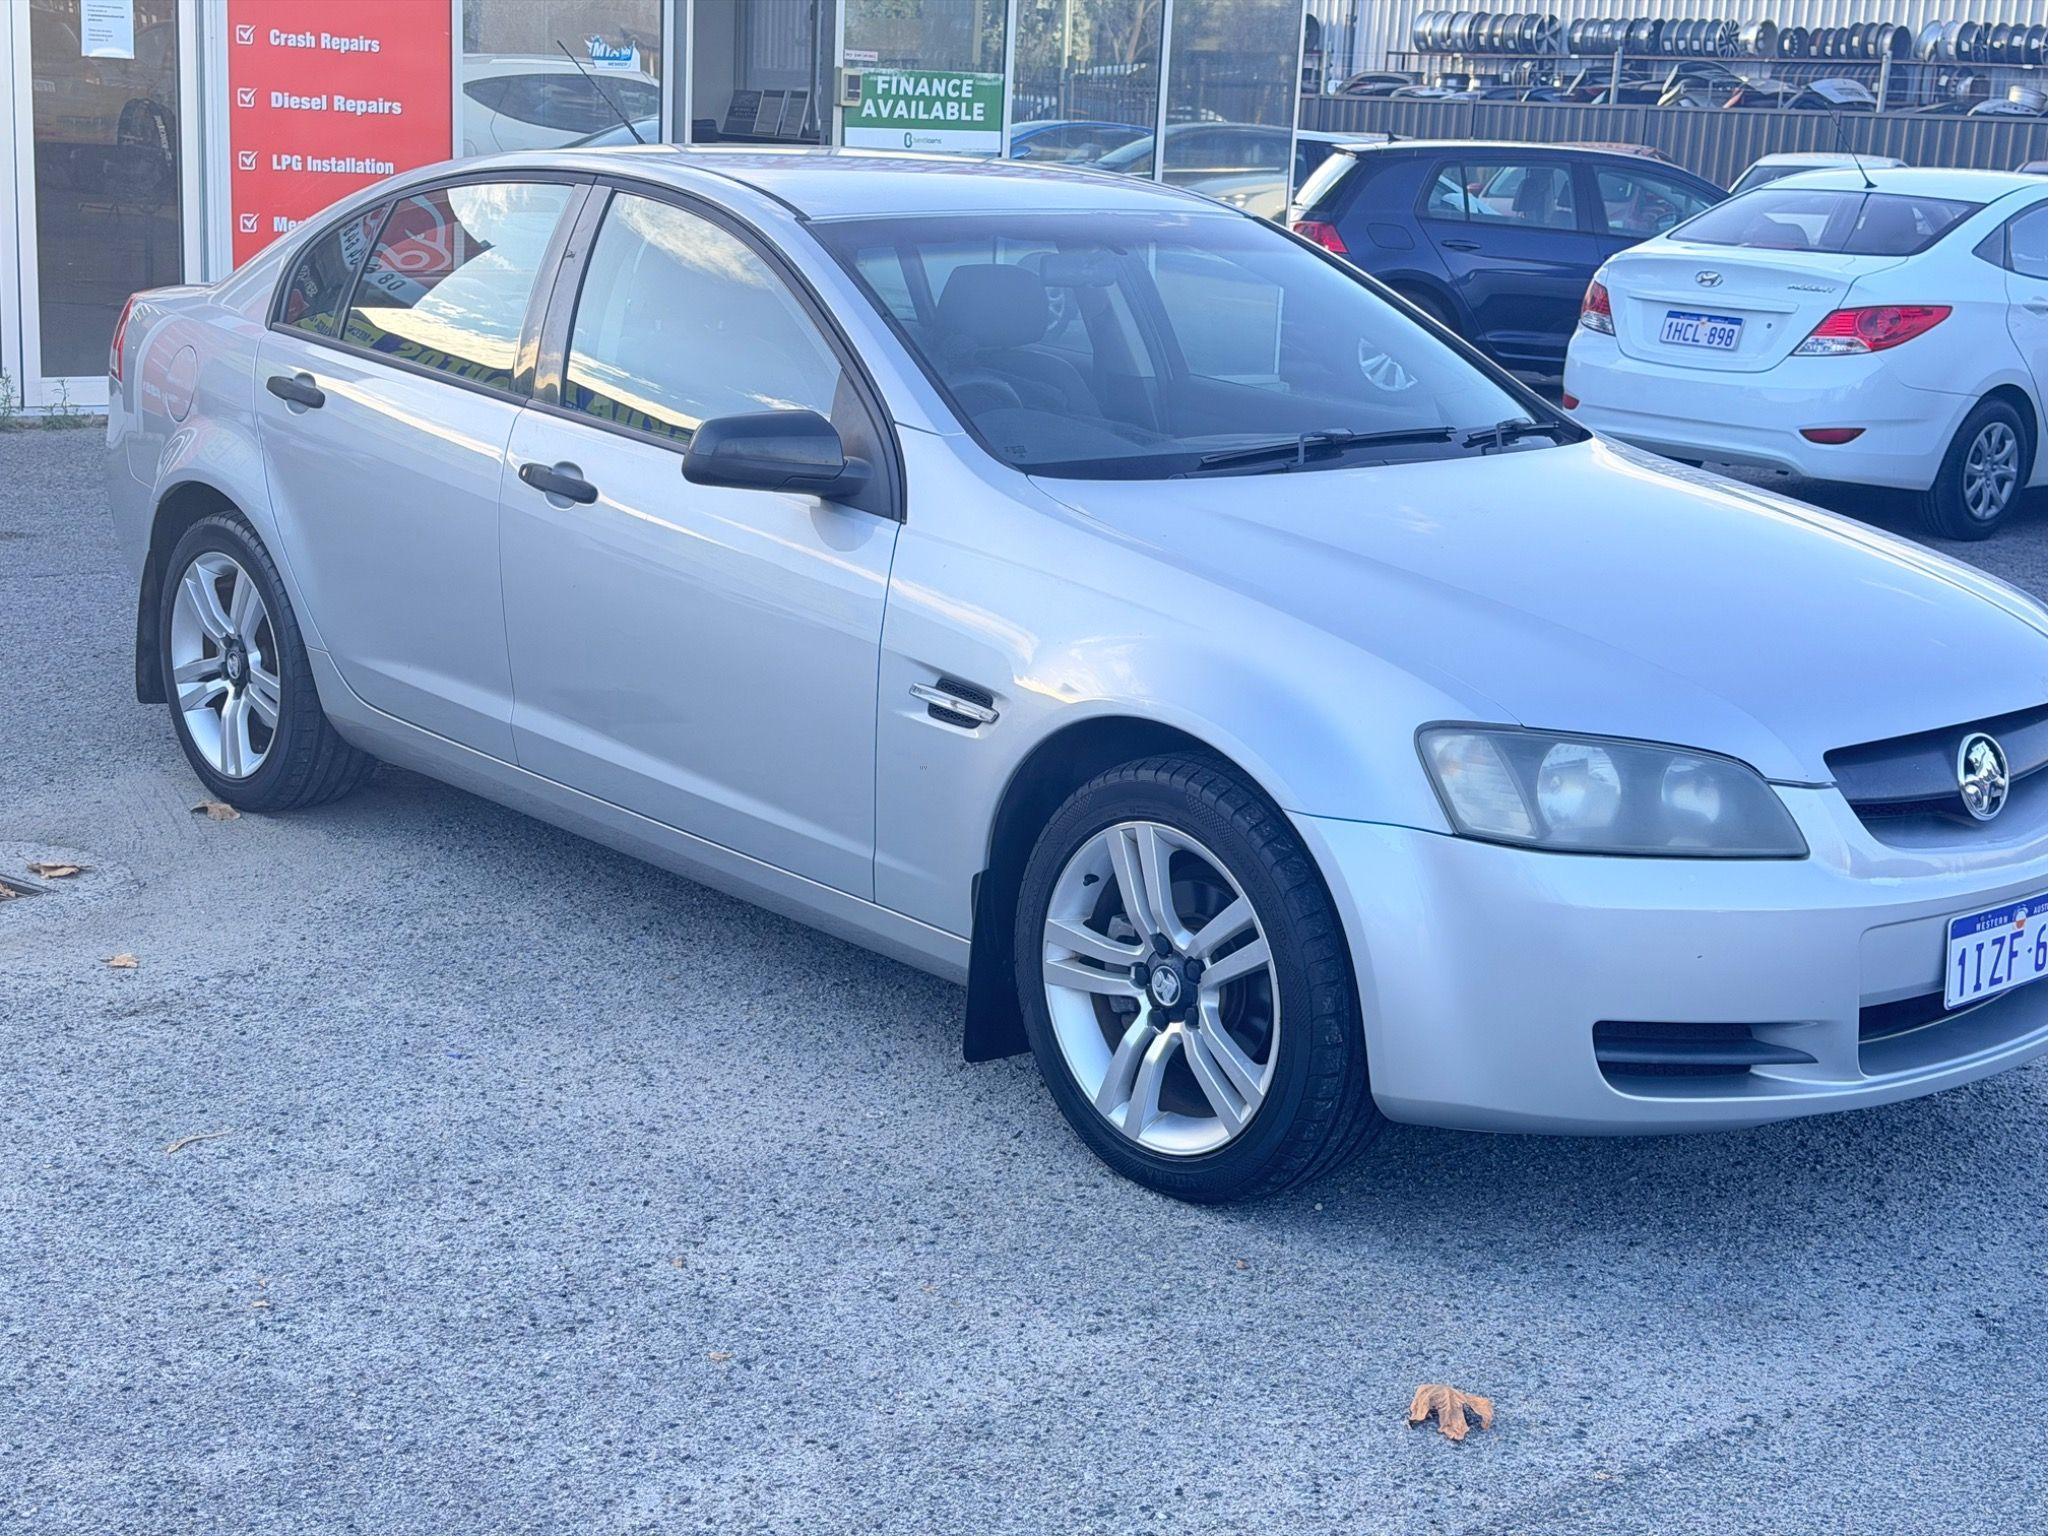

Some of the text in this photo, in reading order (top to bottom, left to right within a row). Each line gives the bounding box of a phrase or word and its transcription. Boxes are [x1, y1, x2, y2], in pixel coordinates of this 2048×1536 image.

[269, 29, 381, 53] Crash Repairs
[877, 75, 974, 98] FINANCE
[271, 92, 403, 115] Diesel Repairs
[861, 98, 985, 121] AVAILABLE
[272, 154, 395, 175] LPG Installation
[1976, 915, 2008, 932] WESTERN
